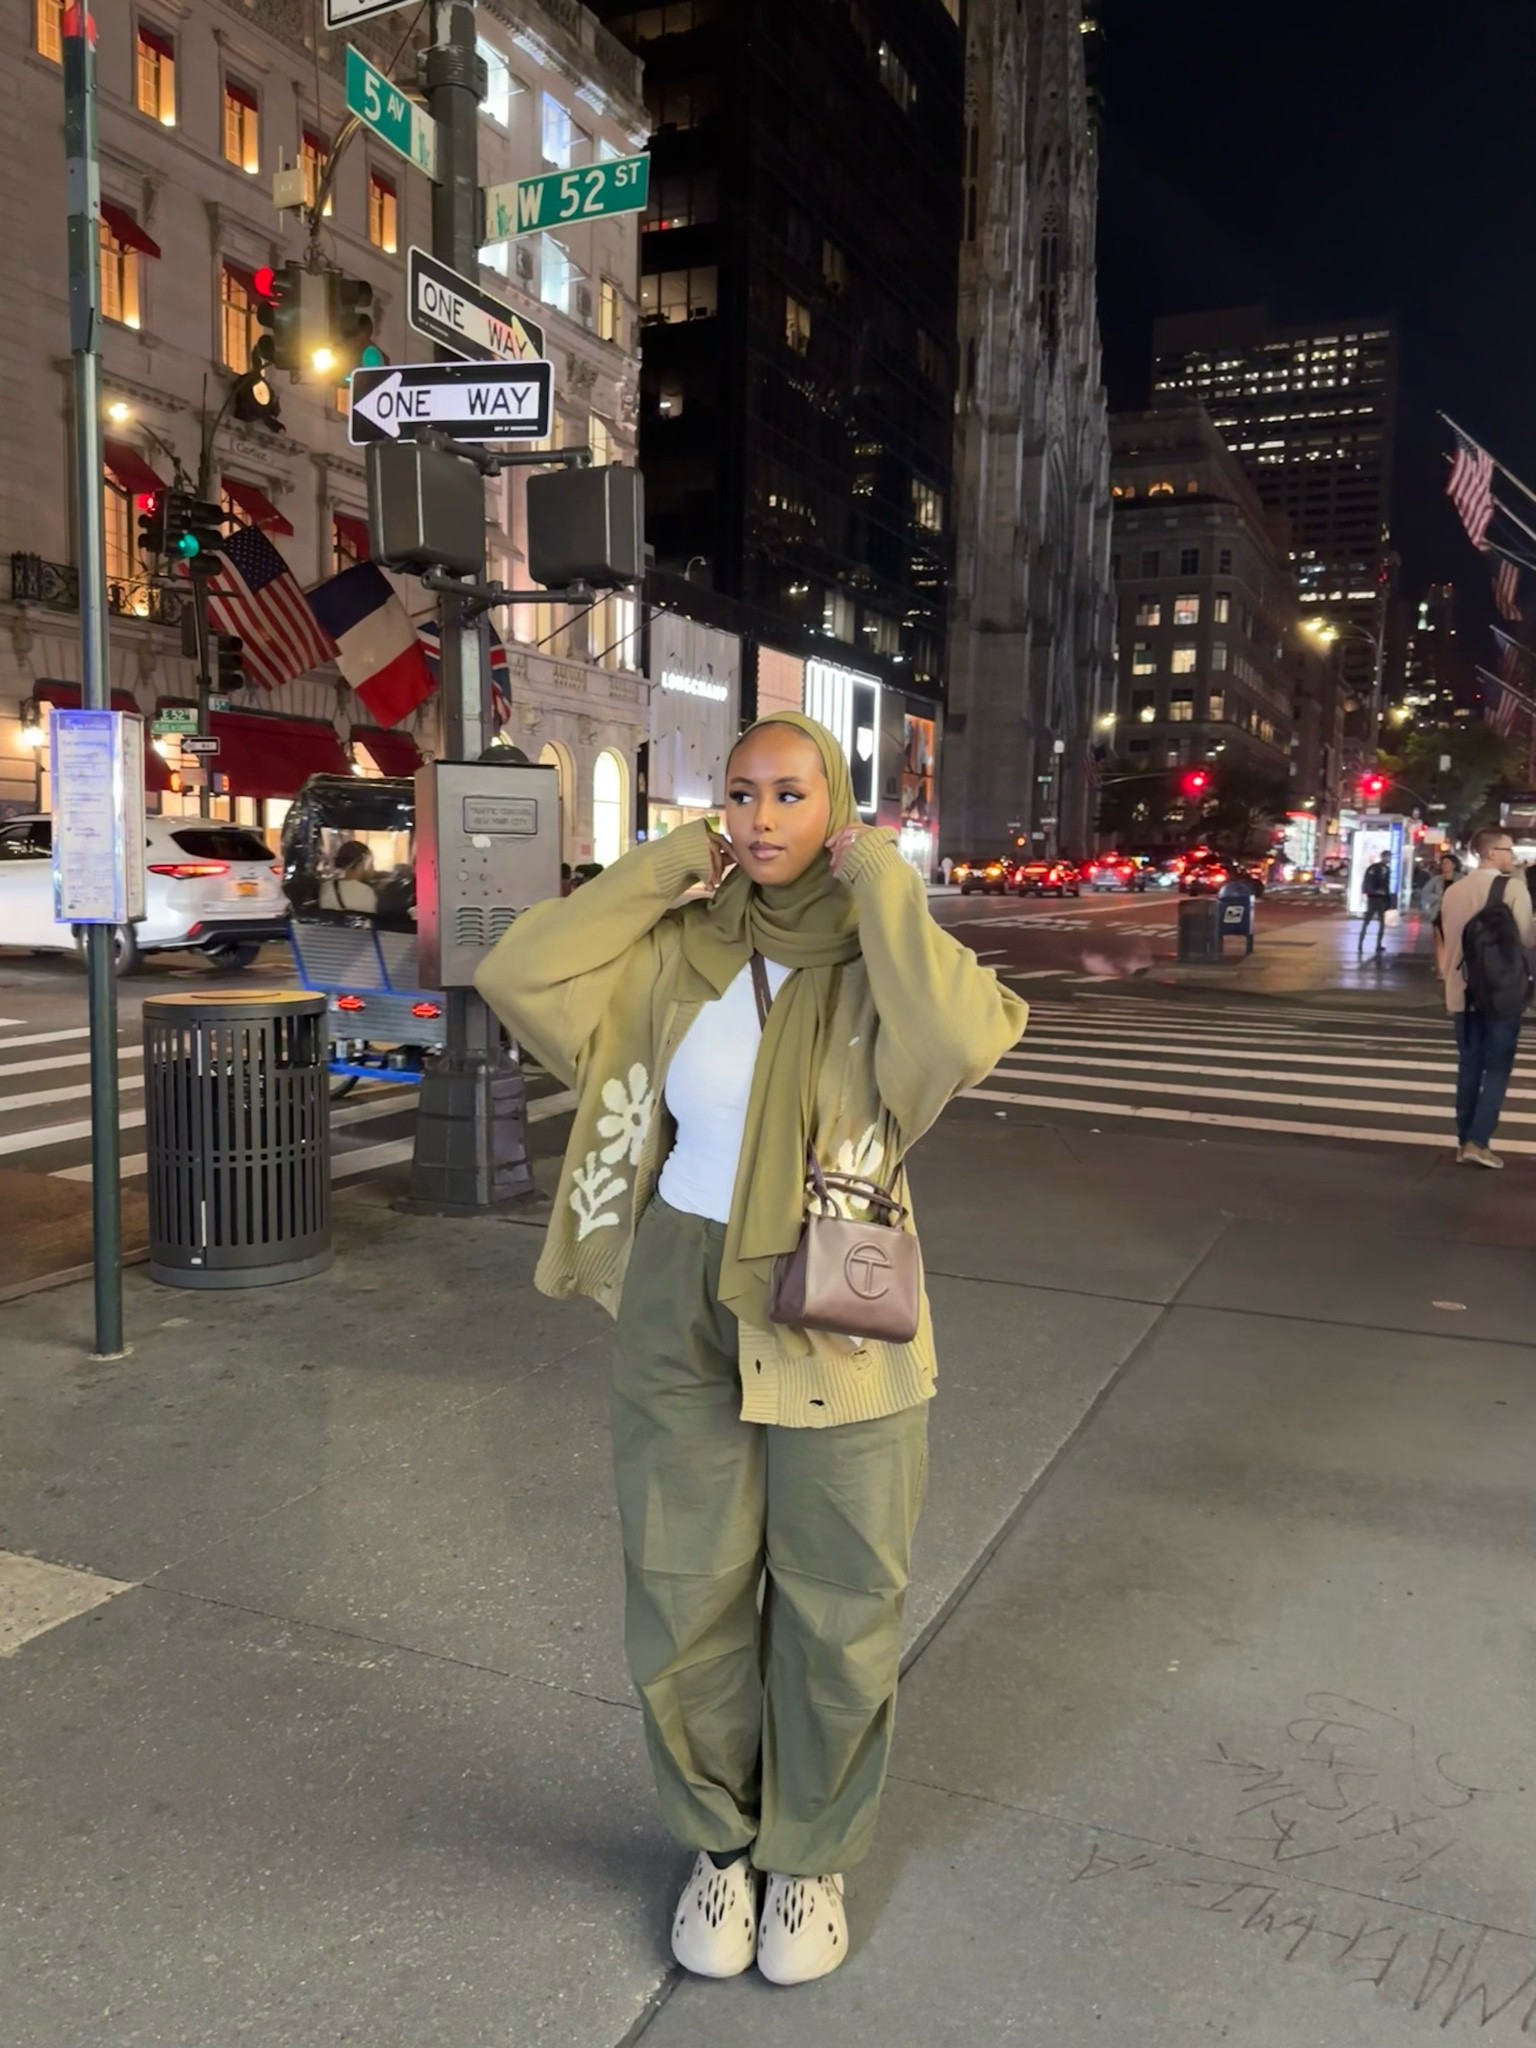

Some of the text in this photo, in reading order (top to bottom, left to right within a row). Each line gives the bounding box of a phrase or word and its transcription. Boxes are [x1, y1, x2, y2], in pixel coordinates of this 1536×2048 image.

[364, 69, 405, 123] 5 AV
[519, 161, 641, 227] W 52 ST
[423, 281, 465, 331] ONE
[488, 318, 528, 361] WAY
[376, 386, 531, 419] ONE WAY
